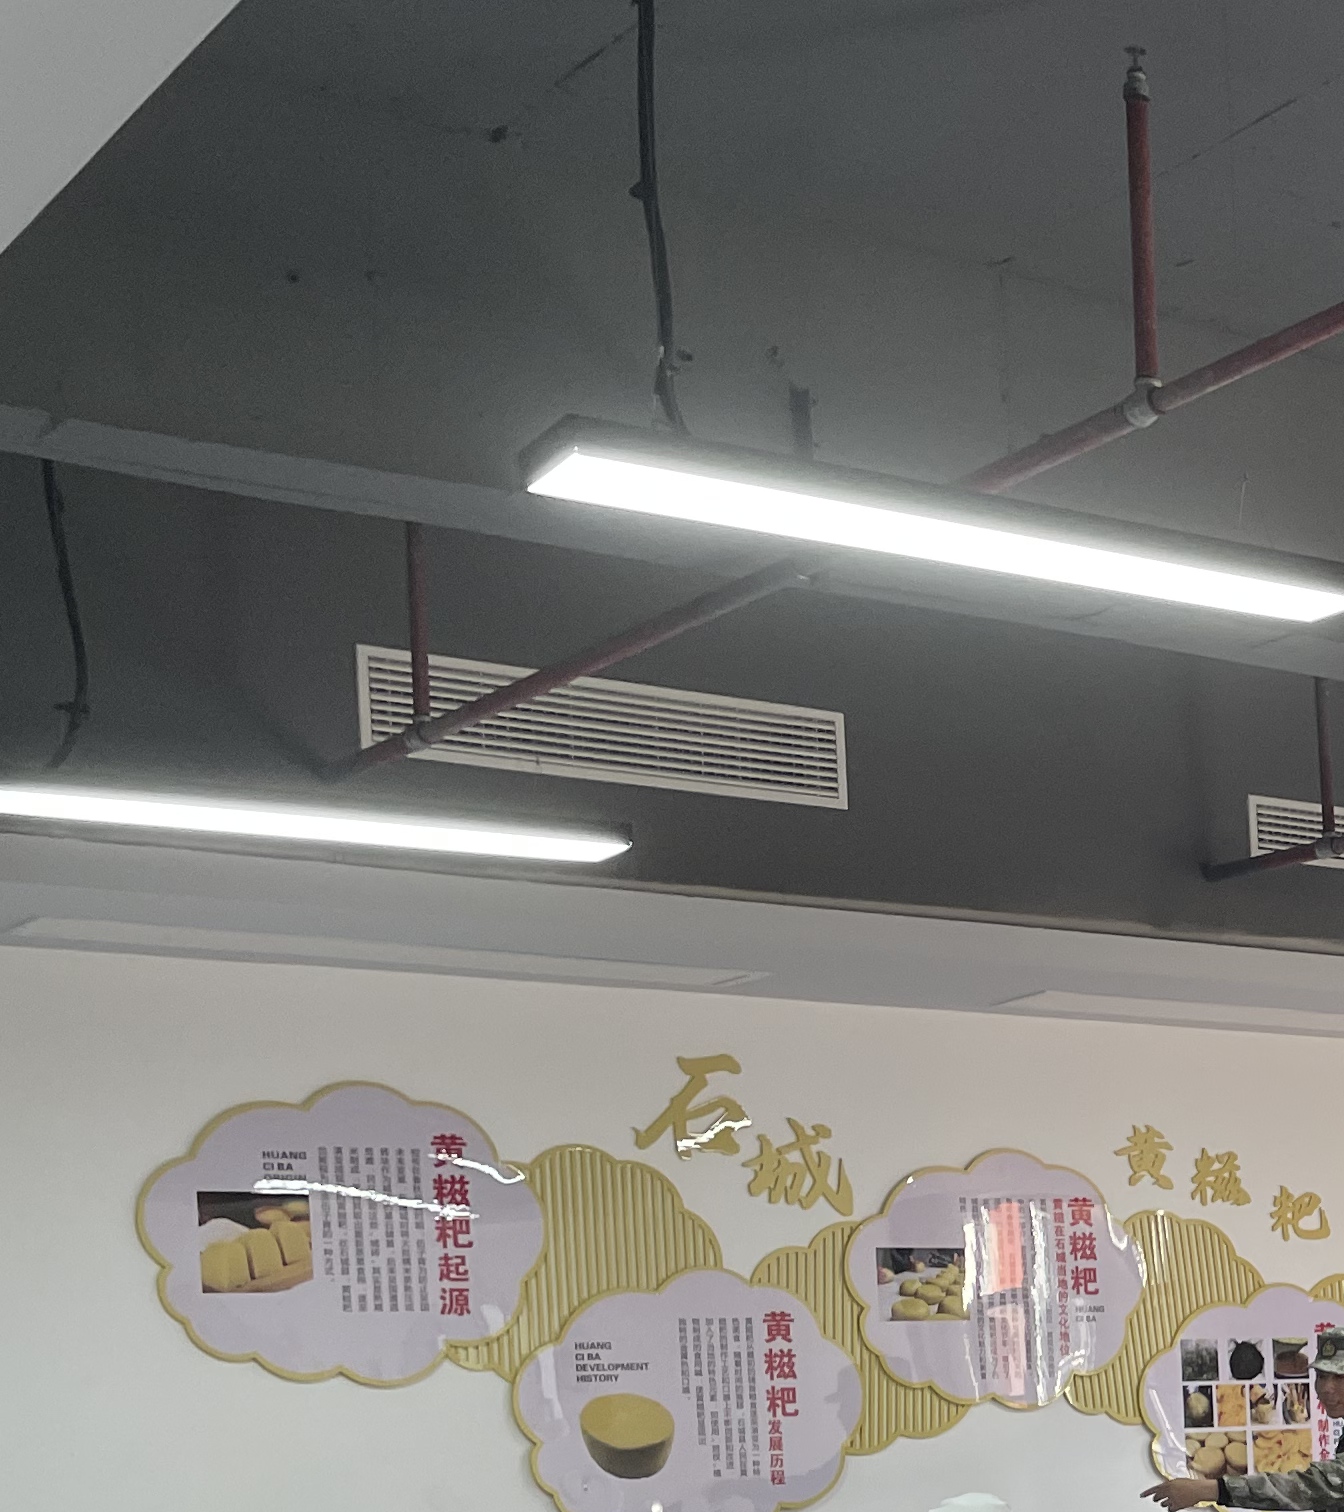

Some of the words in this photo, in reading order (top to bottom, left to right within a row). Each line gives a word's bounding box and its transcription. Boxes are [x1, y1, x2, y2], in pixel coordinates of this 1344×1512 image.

[632, 1053, 853, 1217] 石城
[1113, 1124, 1331, 1242] 黄糍粑
[262, 1151, 307, 1160] HUANG
[262, 1162, 274, 1171] CI
[277, 1162, 294, 1171] BA
[430, 1133, 475, 1317] 黄糍粑起源
[1067, 1197, 1100, 1296] 黄糍粑
[574, 1341, 612, 1350] HUANG
[575, 1352, 585, 1361] CI
[586, 1352, 601, 1361] BA
[575, 1362, 650, 1372] DEVELOPMENT
[576, 1374, 620, 1383] HISTORY
